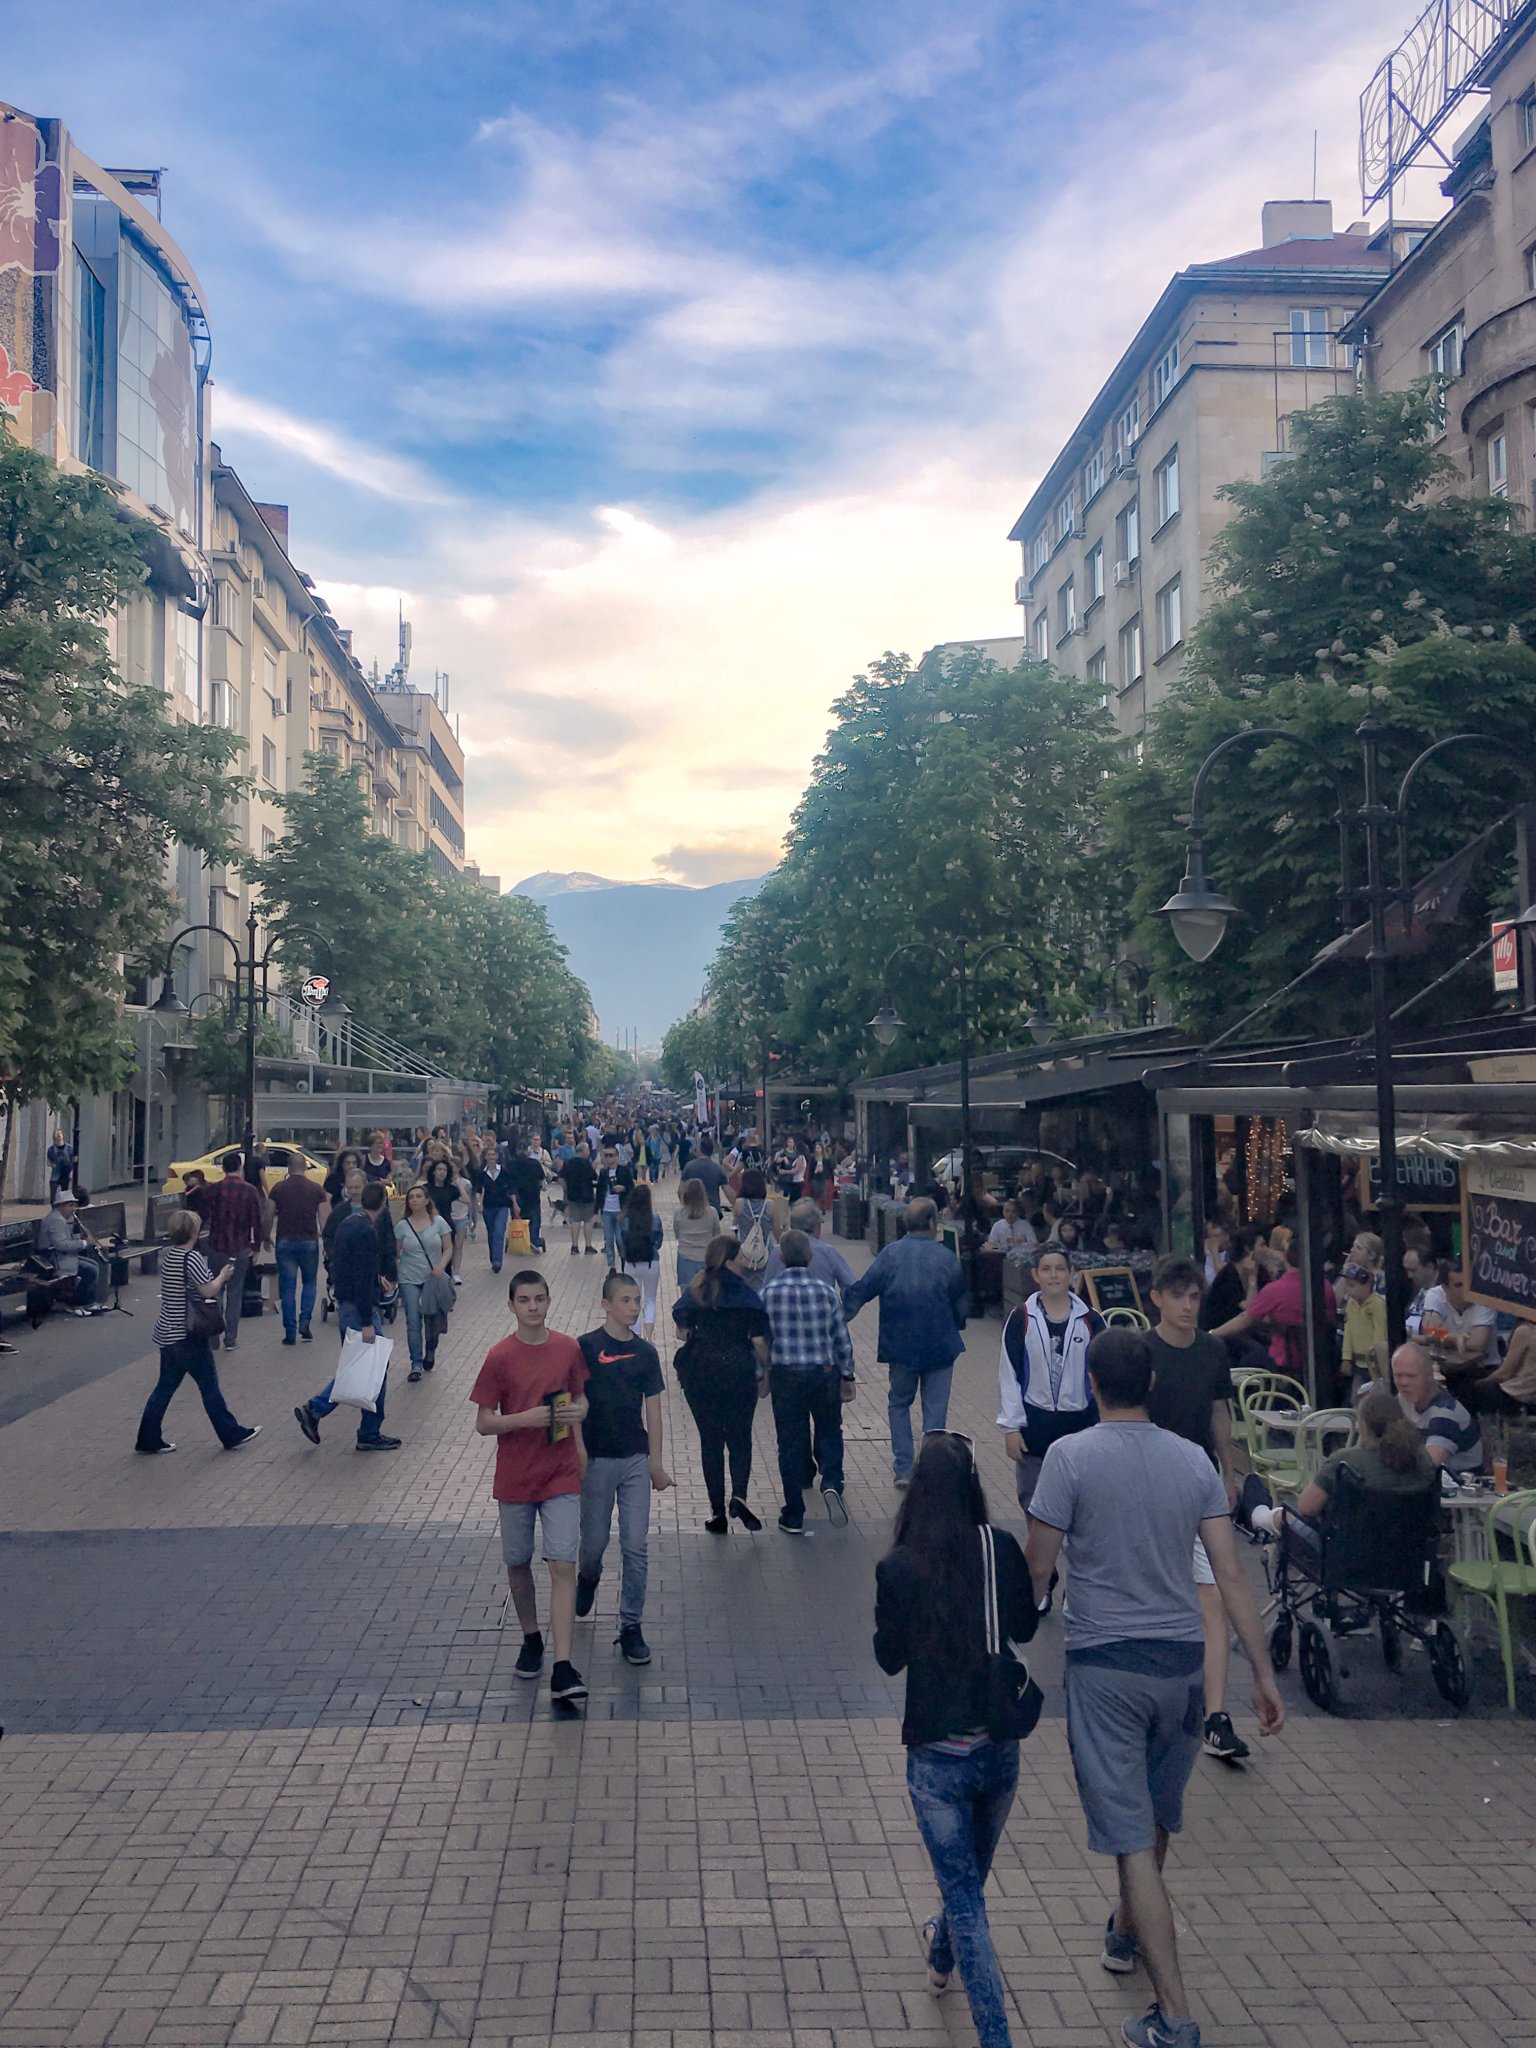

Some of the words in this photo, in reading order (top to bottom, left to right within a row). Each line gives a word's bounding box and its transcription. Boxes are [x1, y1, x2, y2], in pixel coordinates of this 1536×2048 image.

[1483, 1201, 1523, 1245] Bar
[1495, 1241, 1518, 1262] and
[1479, 1252, 1530, 1297] Dinner
